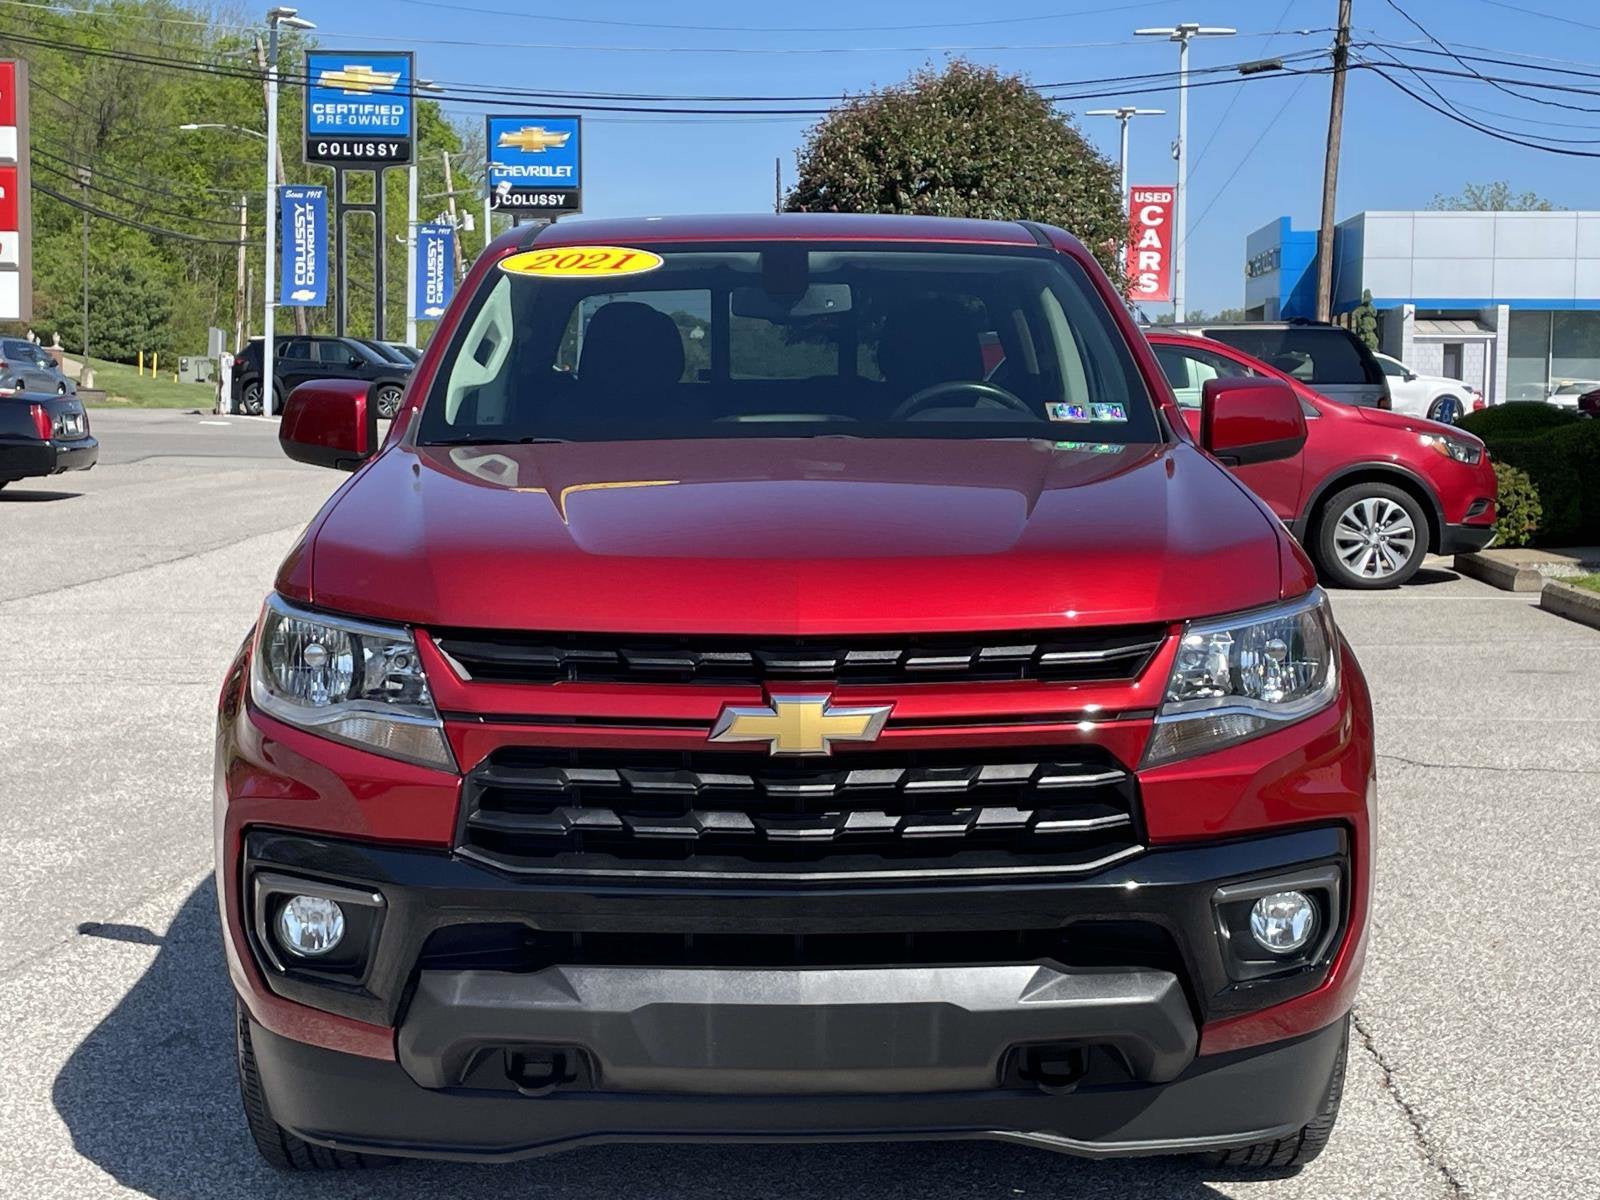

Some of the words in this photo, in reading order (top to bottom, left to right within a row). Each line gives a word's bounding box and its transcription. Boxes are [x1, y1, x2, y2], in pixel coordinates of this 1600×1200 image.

[312, 103, 404, 115] CERTIFIED
[316, 115, 400, 126] PRE-OWNED
[317, 142, 399, 156] COLUSSY
[502, 194, 566, 205] COLUSSY
[1134, 192, 1172, 203] USED
[294, 203, 306, 285] COLUSSY
[306, 203, 315, 285] CHEVROLET
[1138, 205, 1164, 293] CARS
[524, 253, 637, 270] 2021
[426, 238, 437, 304] COLUSSY
[436, 238, 445, 304] CHEVROLET
